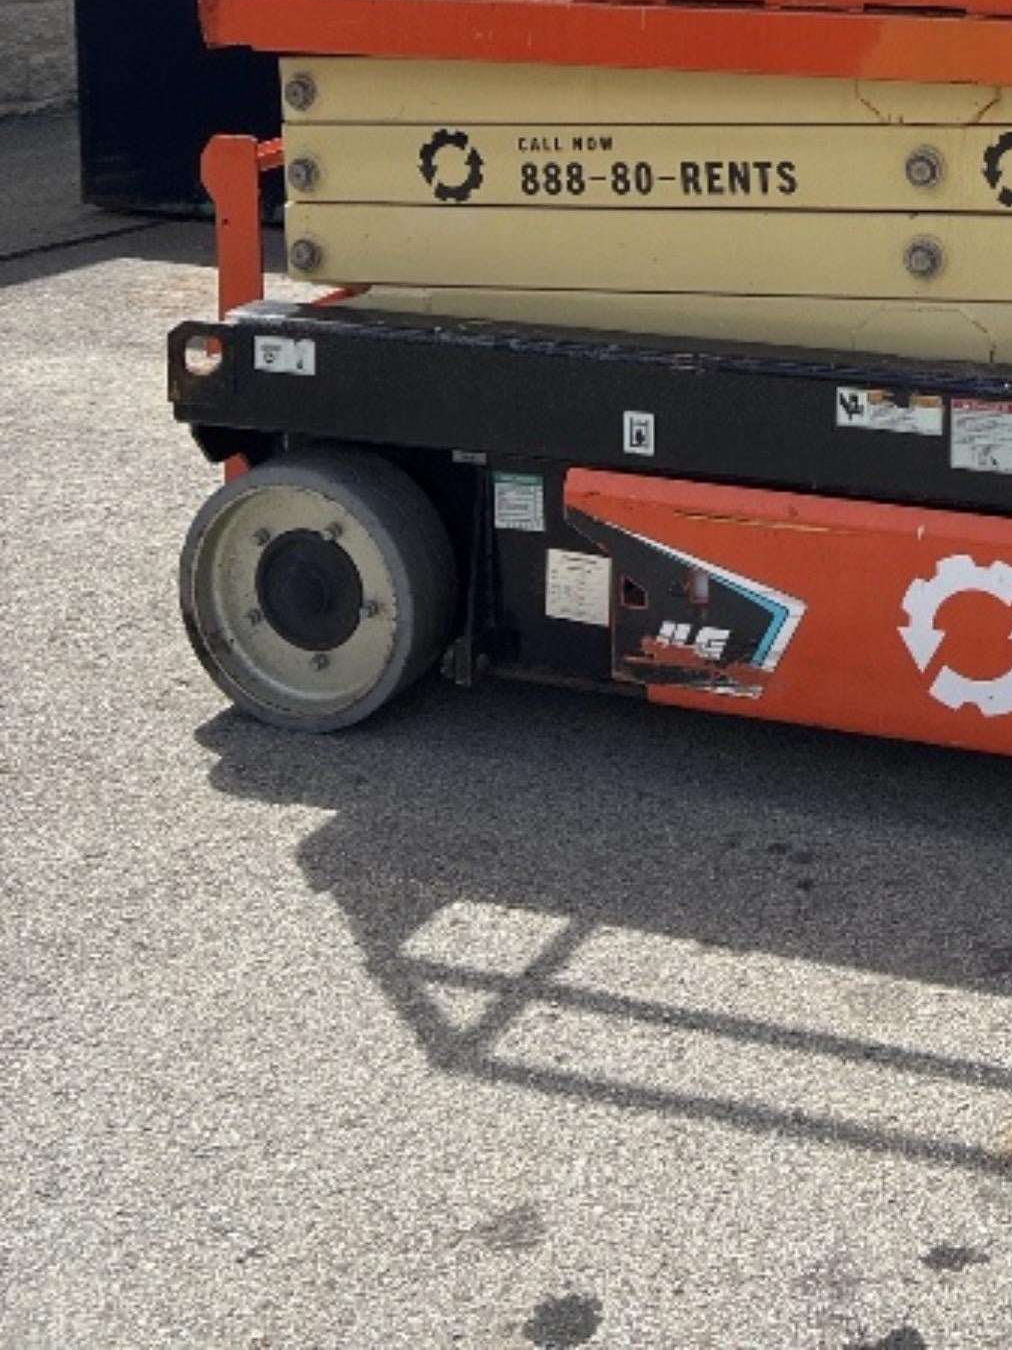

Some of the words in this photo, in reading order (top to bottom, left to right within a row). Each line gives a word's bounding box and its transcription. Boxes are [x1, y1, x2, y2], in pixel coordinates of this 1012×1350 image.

[517, 136, 562, 152] CALL
[572, 136, 613, 152] NOW
[520, 161, 799, 197] 888-80-RENTS
